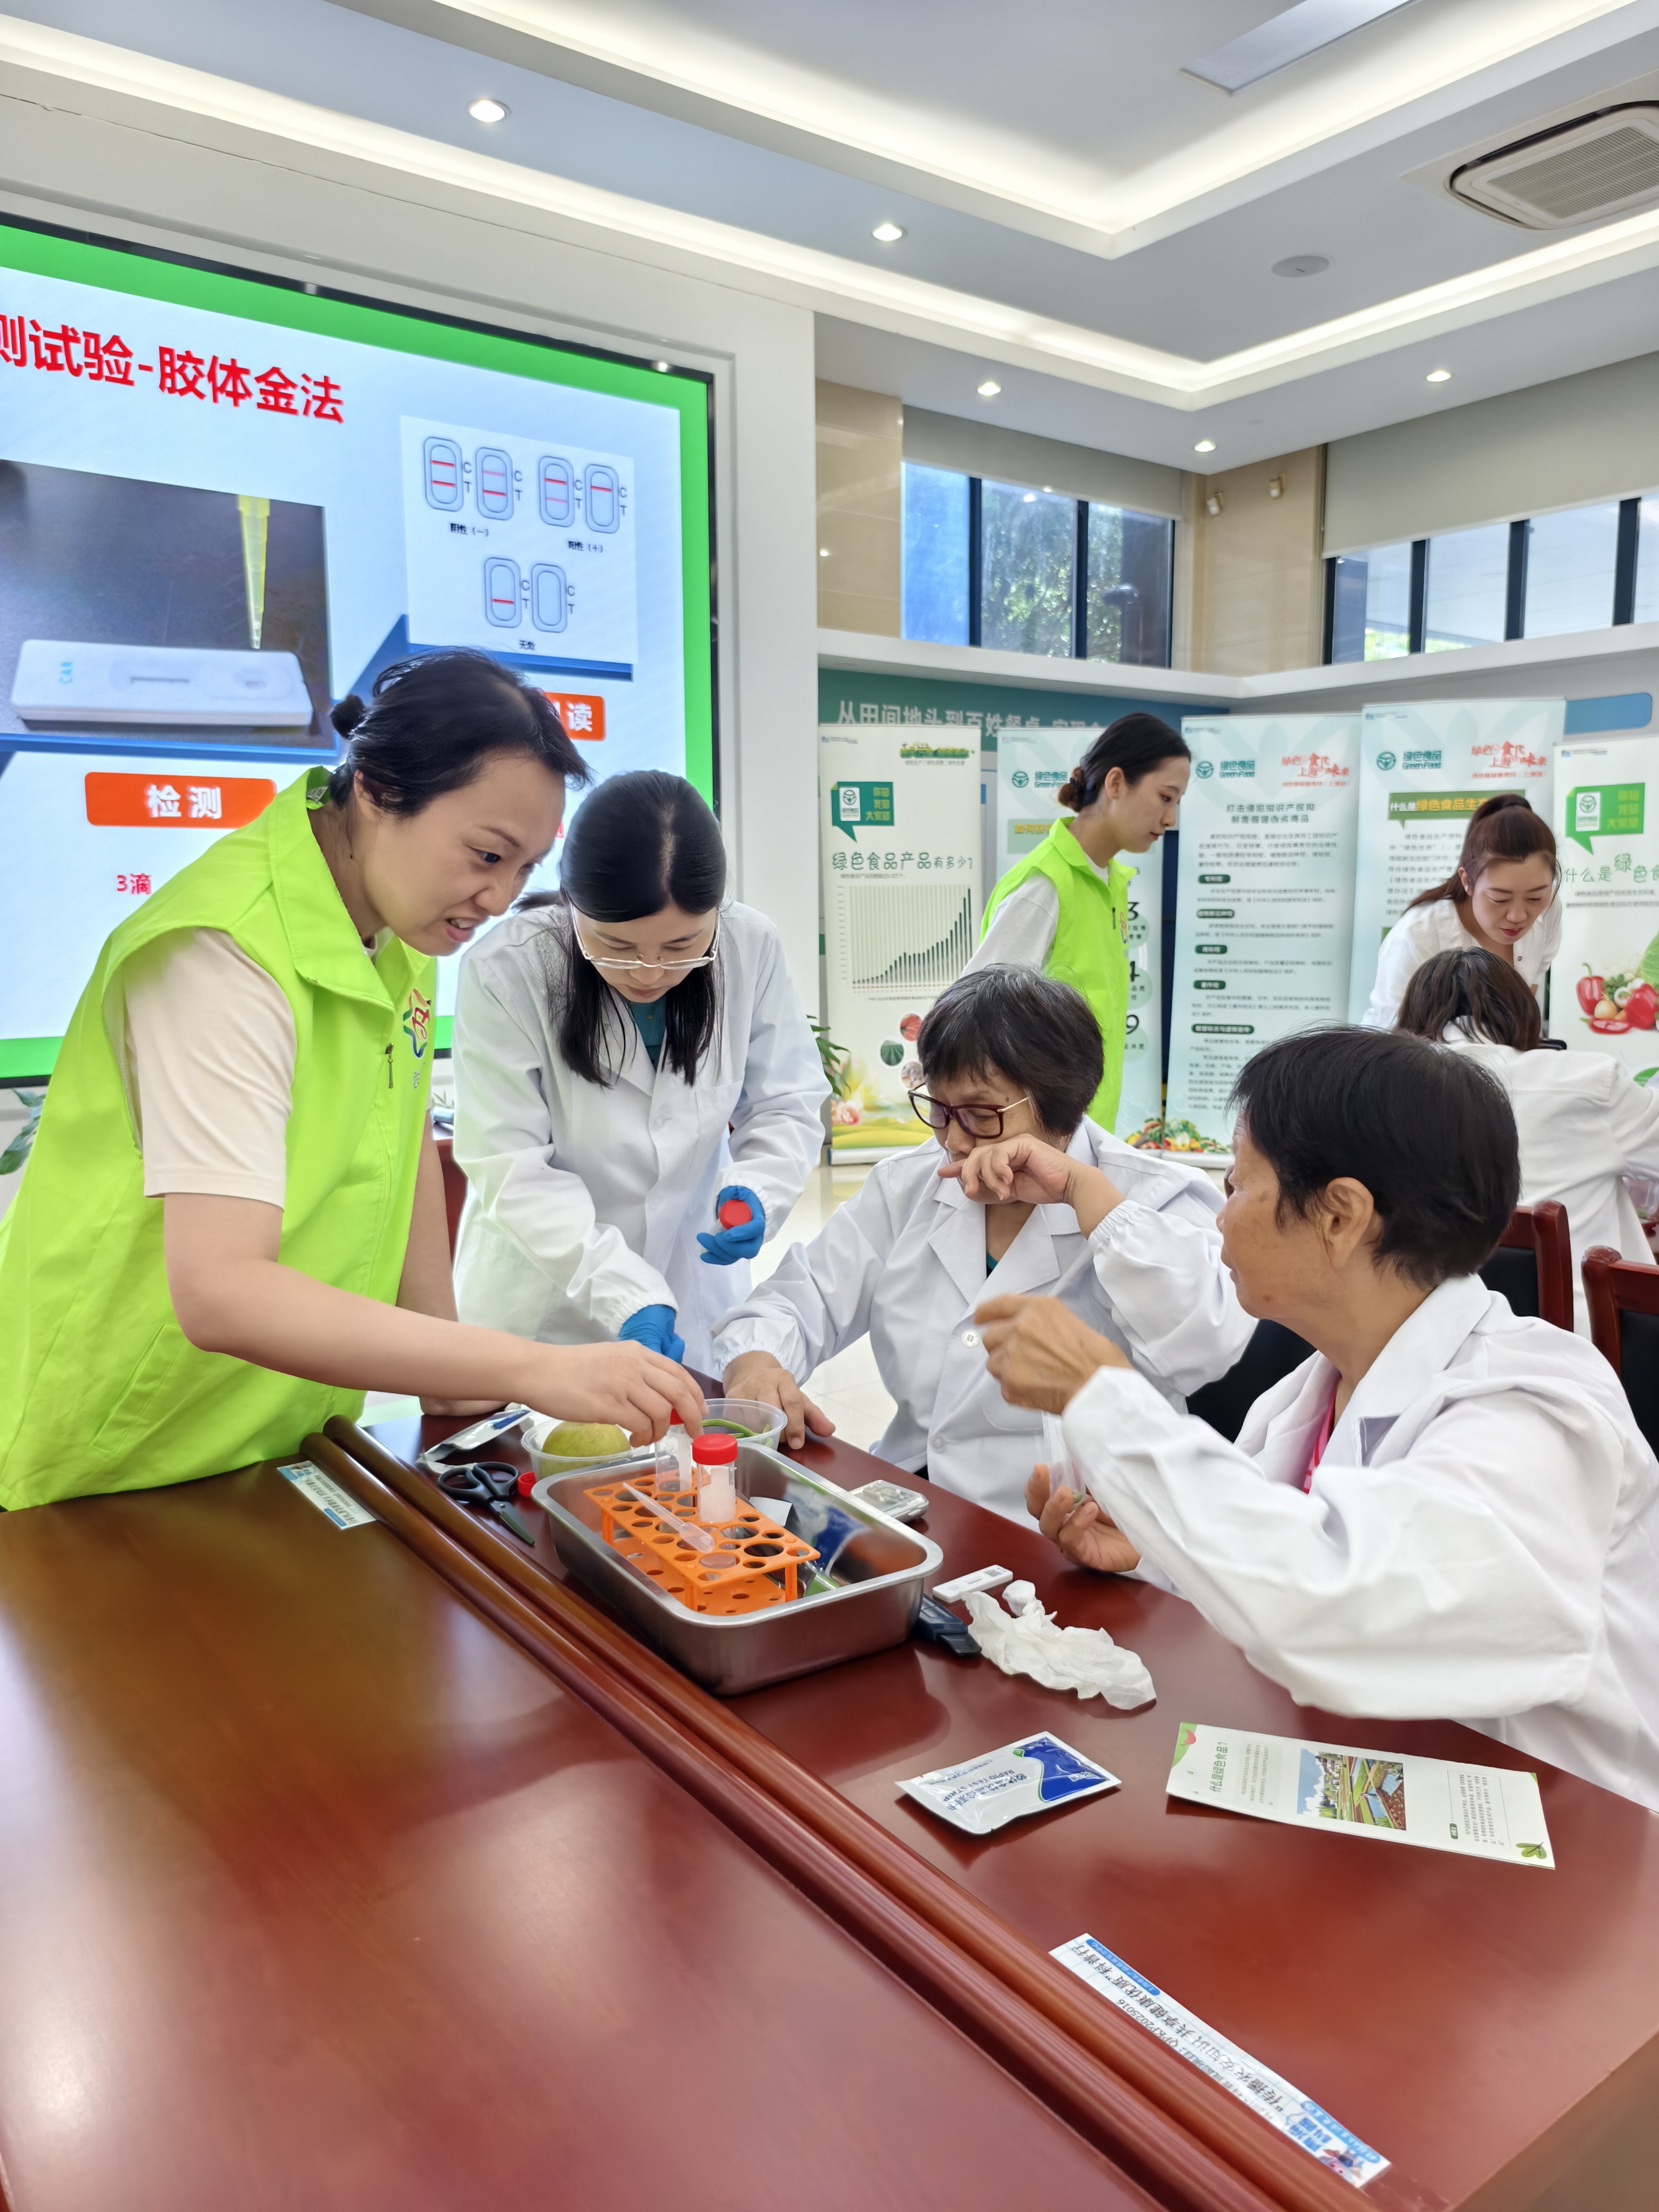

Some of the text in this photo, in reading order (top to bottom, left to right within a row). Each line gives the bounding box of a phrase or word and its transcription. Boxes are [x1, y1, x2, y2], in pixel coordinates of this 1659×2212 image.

[463, 462, 472, 474] C
[514, 470, 523, 482] C
[464, 481, 471, 493] T
[574, 480, 583, 490] C
[515, 489, 523, 501] T
[619, 488, 628, 498] C
[576, 498, 583, 509] T
[620, 505, 627, 516] T
[521, 579, 530, 591] C
[567, 585, 576, 596] C
[522, 598, 530, 609] T
[568, 603, 575, 614] T
[554, 703, 592, 732] 读
[147, 784, 222, 819] 检测
[989, 1769, 1015, 1780] RAPID
[944, 1786, 967, 1802] STRIP
